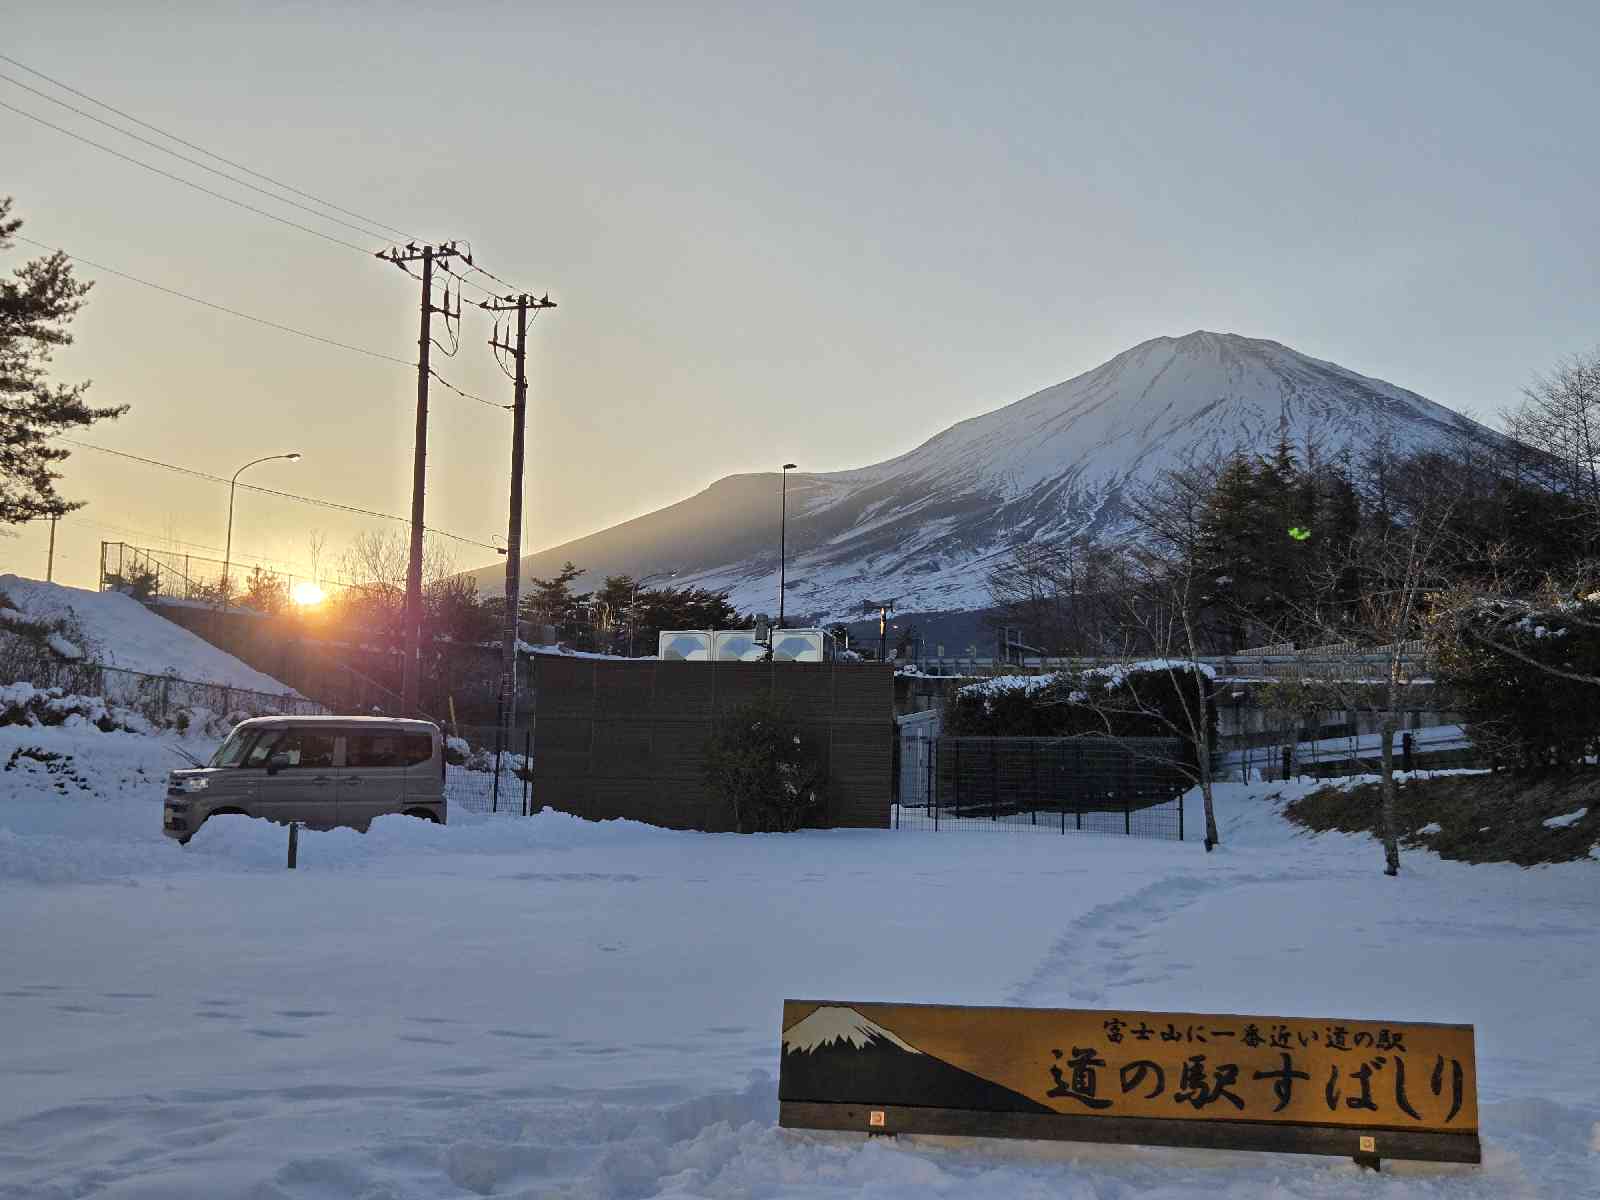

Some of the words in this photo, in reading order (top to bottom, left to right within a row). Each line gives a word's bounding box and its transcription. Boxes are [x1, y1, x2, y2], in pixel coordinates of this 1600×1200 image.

[1103, 1018, 1407, 1052] 富士山に一番近い道の駅
[1046, 1046, 1464, 1123] 道の駅すばしり
